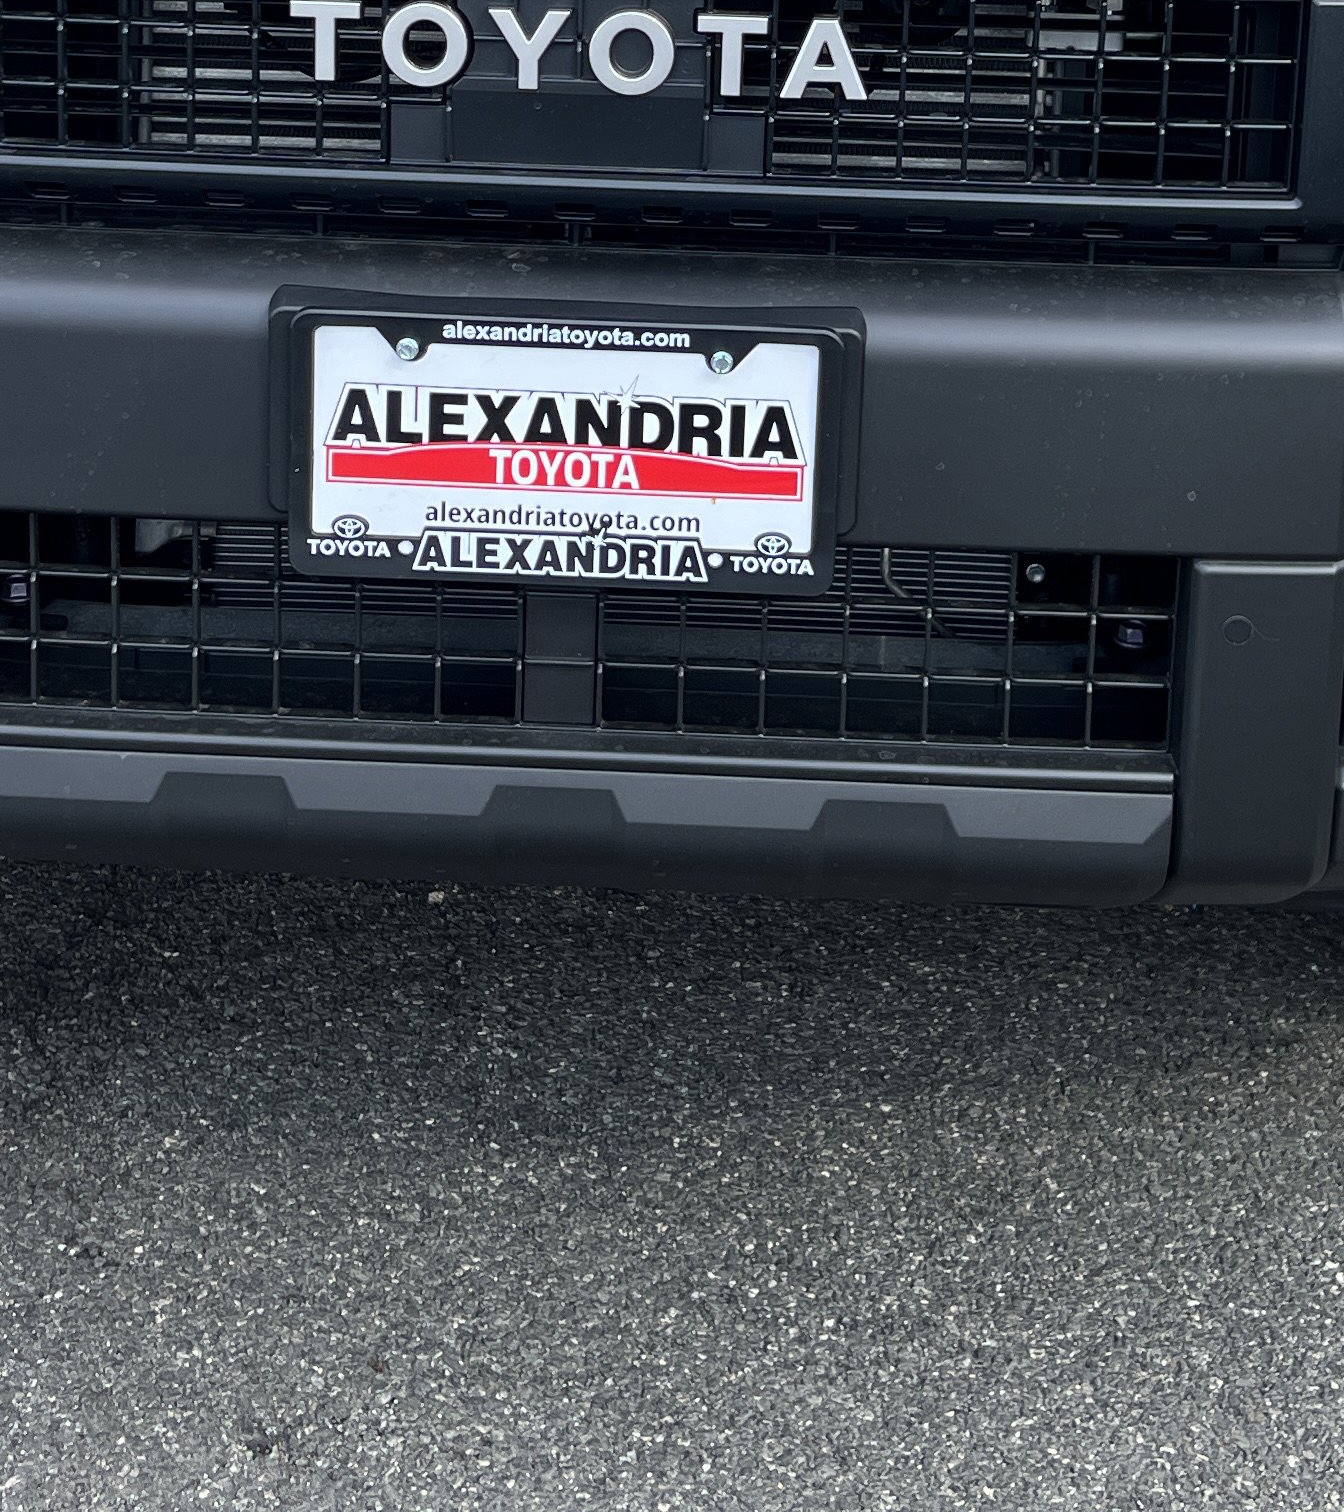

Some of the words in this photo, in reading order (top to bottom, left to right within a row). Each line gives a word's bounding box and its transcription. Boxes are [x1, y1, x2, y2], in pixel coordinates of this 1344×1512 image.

[442, 320, 691, 349] alexandriatoyota.com
[329, 385, 801, 461] ALEXANDRIA
[488, 448, 641, 490] TOYOTA
[424, 500, 701, 534] alexandriatoyota.com
[306, 538, 392, 558] TOYOTA
[414, 531, 706, 580] ALEXANDRIA
[729, 555, 815, 576] TOYOTA
